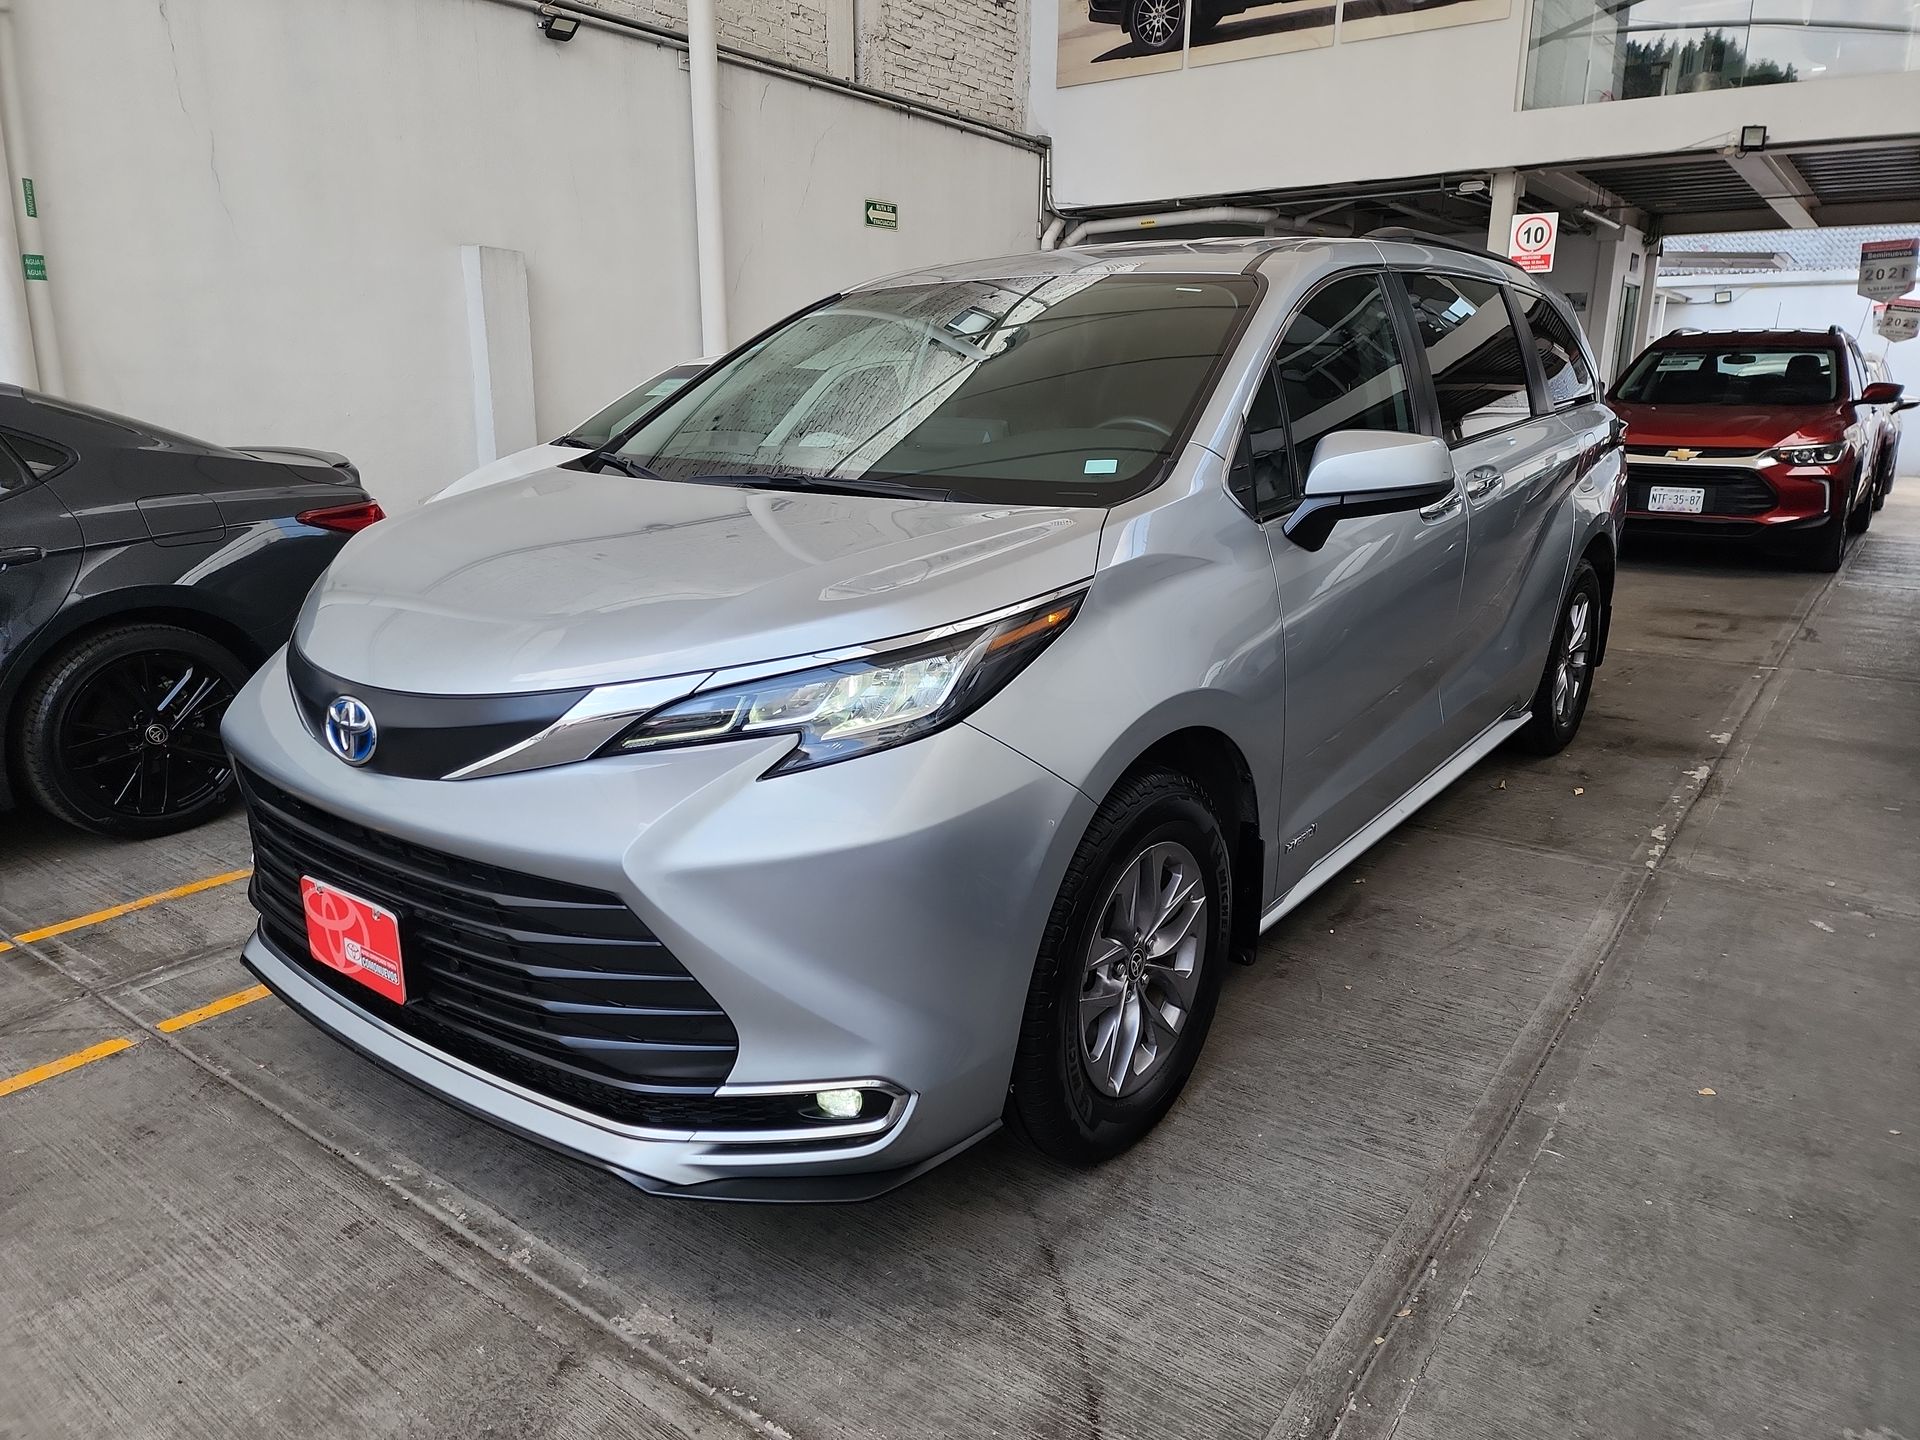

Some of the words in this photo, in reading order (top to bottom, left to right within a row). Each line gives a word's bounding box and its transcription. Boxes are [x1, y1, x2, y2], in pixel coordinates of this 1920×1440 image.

[1523, 226, 1544, 244] 10
[1868, 250, 1912, 260] Seminuevos
[1651, 493, 1701, 505] NTF-35-87
